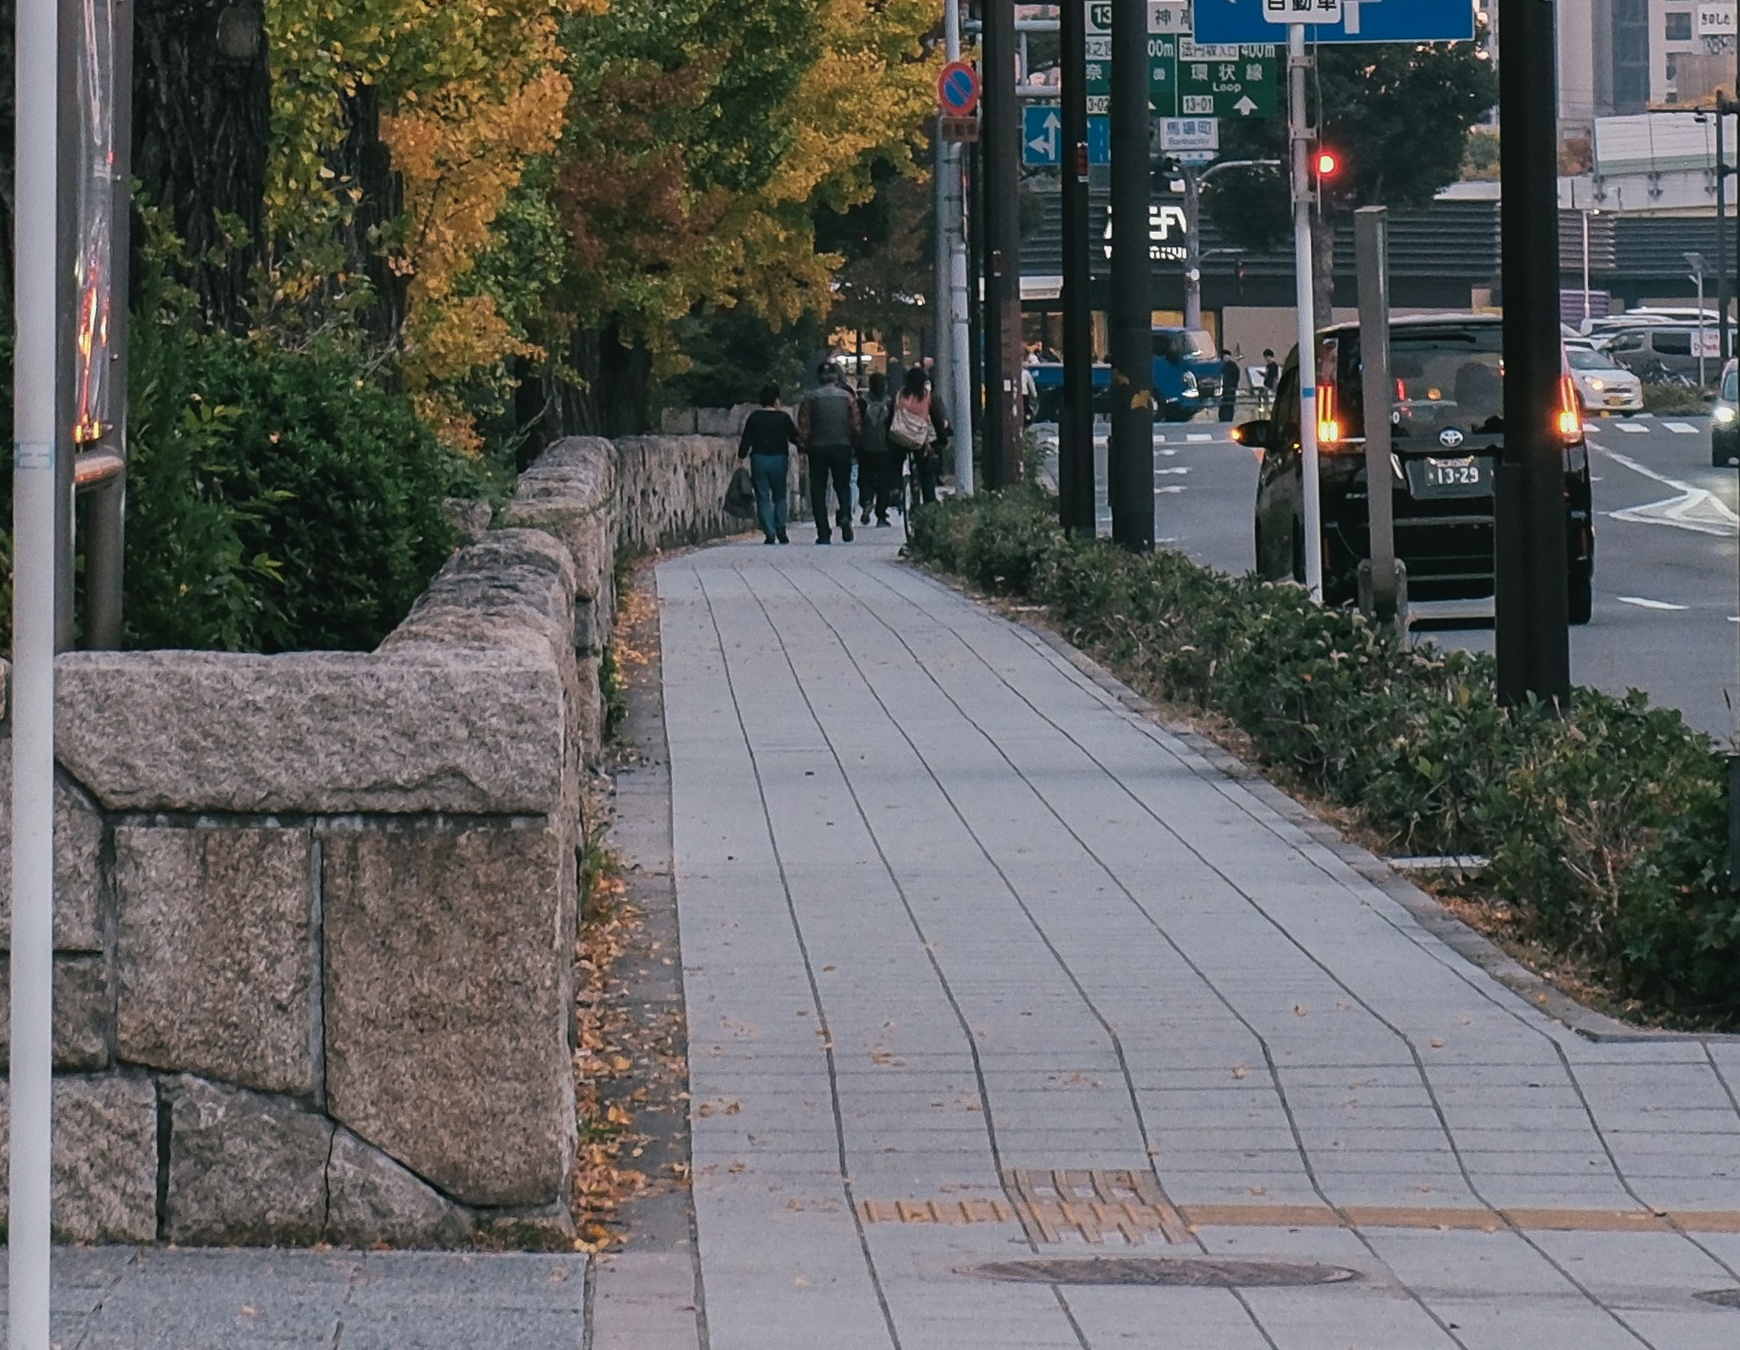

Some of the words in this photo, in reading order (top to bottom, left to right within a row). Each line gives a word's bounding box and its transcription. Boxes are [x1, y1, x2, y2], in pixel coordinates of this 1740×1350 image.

[1190, 63, 1263, 82] 環状線
[1212, 82, 1242, 93] Loop
